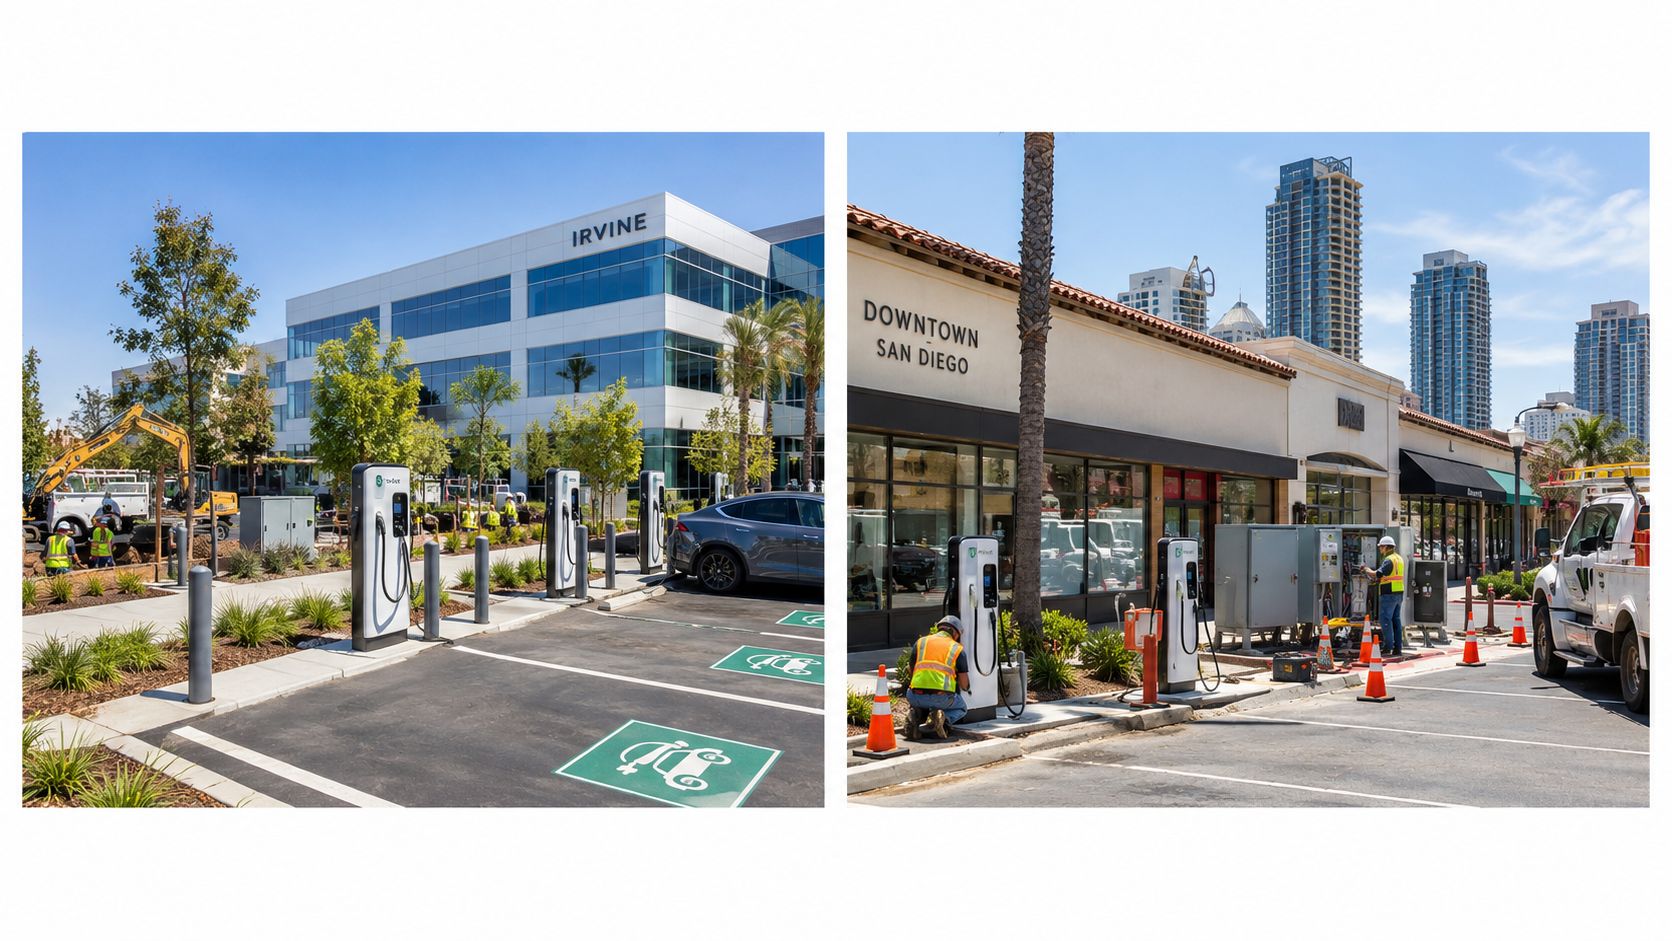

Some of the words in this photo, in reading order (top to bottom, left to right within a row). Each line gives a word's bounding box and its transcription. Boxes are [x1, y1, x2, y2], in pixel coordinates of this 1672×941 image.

[572, 212, 647, 248] IRVINE
[864, 299, 978, 349] DOWNTOWN
[877, 338, 911, 363] SAN
[919, 348, 968, 375] DIEGO
